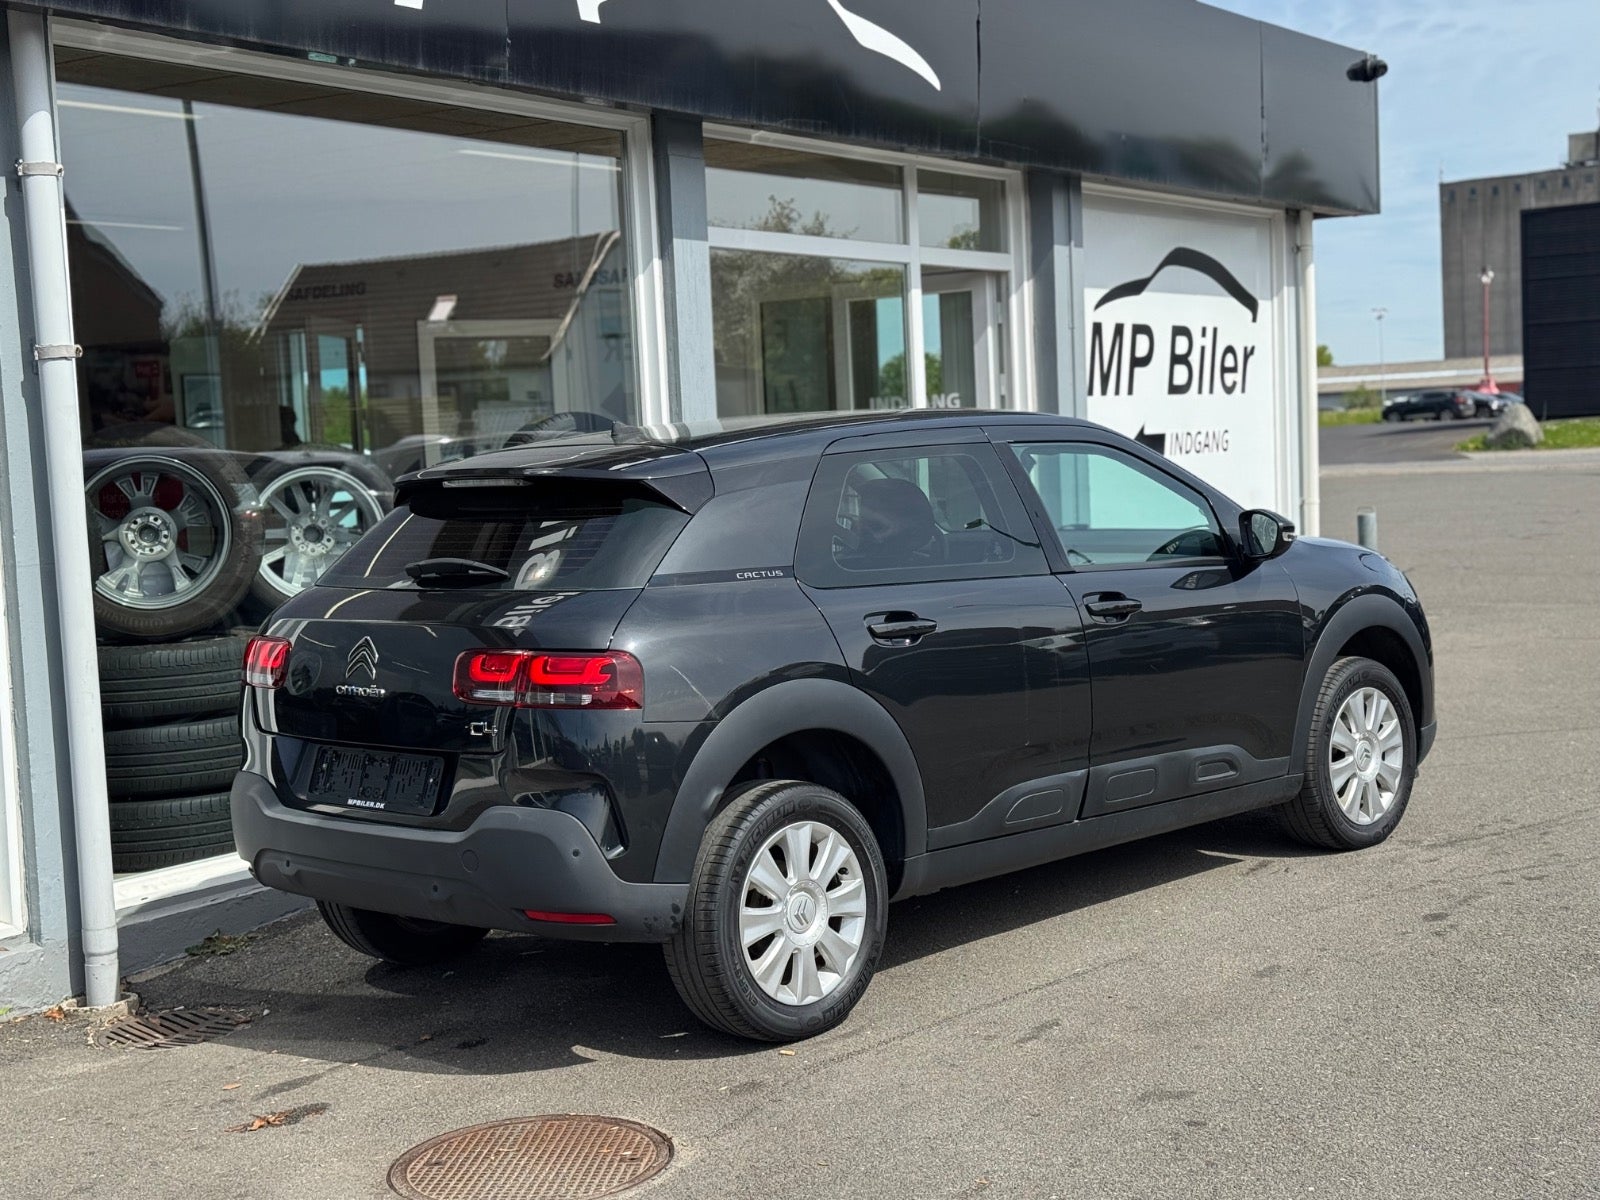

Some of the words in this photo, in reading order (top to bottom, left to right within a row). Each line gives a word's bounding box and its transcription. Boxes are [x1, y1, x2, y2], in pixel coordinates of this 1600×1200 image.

[1087, 322, 1154, 396] MP
[1168, 325, 1255, 395] Biler
[869, 392, 961, 410] INDNG
[1169, 429, 1230, 456] INDGANG
[736, 570, 784, 579] CACTUS
[470, 722, 498, 736] C4
[347, 798, 385, 809] MPBILER.DK
[740, 800, 795, 863] MICHELIN
